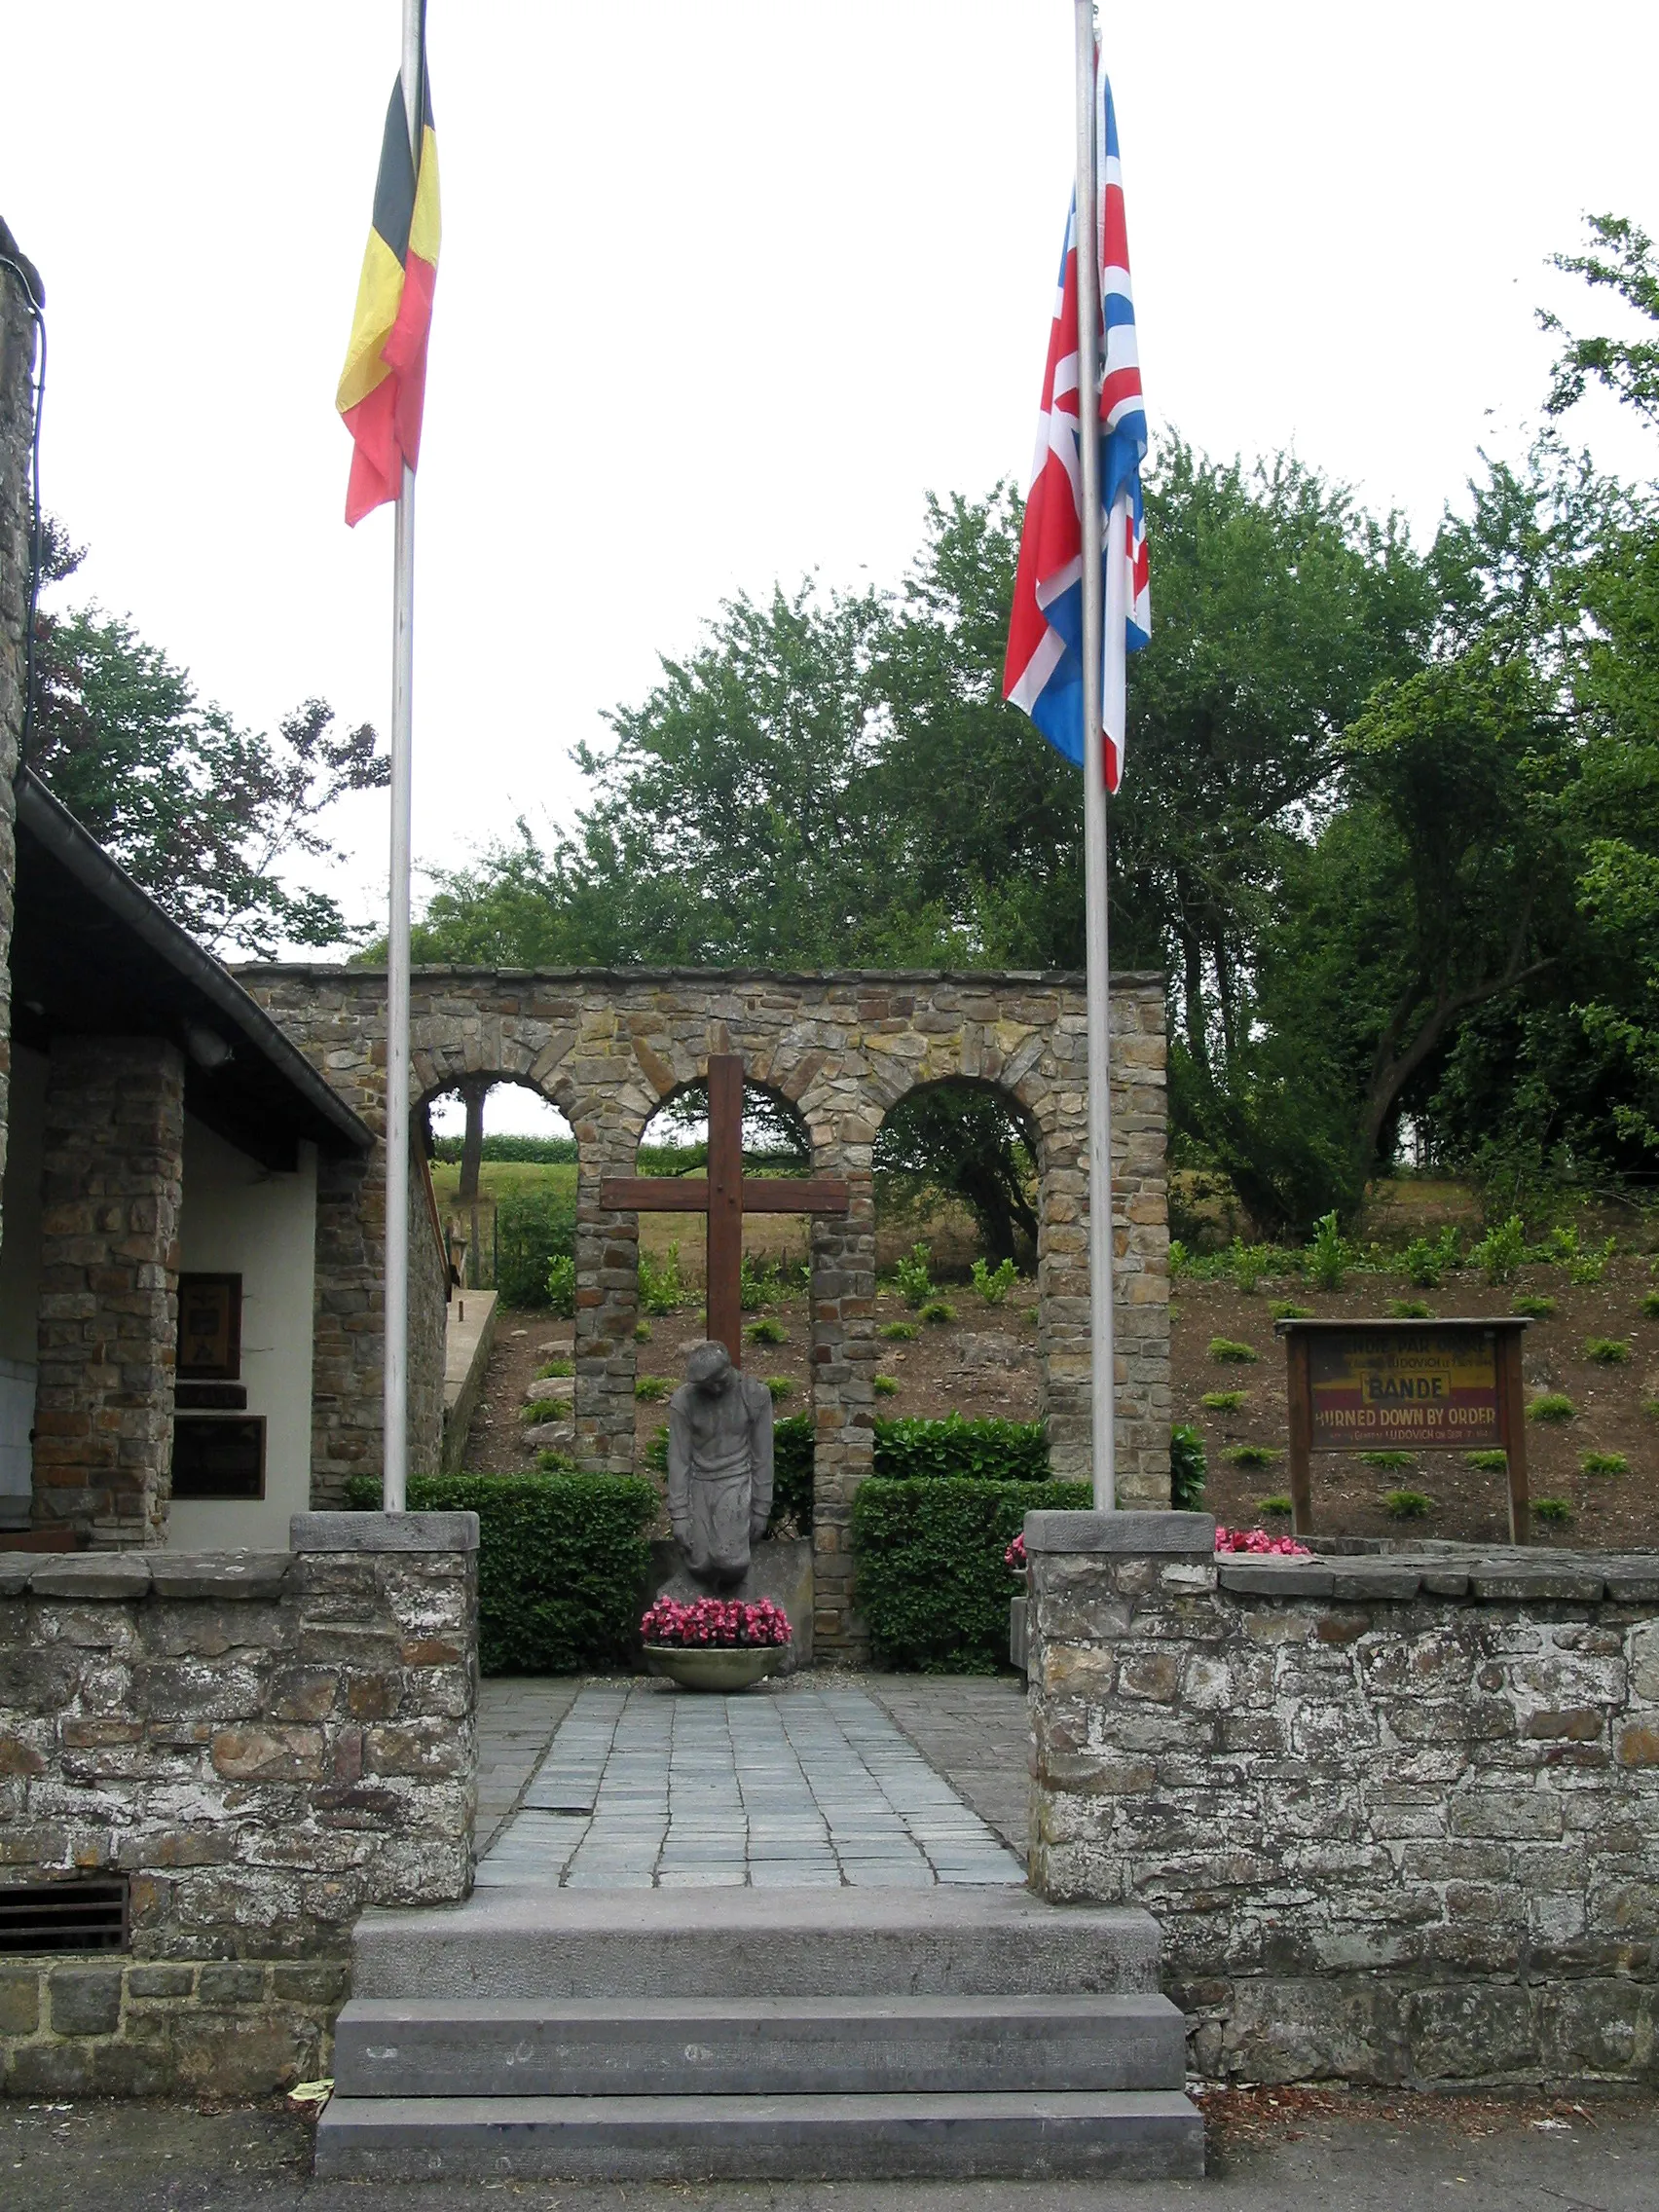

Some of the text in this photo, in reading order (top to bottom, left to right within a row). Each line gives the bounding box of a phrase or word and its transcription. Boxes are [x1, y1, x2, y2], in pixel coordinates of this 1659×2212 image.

[1369, 1377, 1443, 1399] BANDE
[1316, 1407, 1495, 1427] BURNED DOWN BY ORDER
